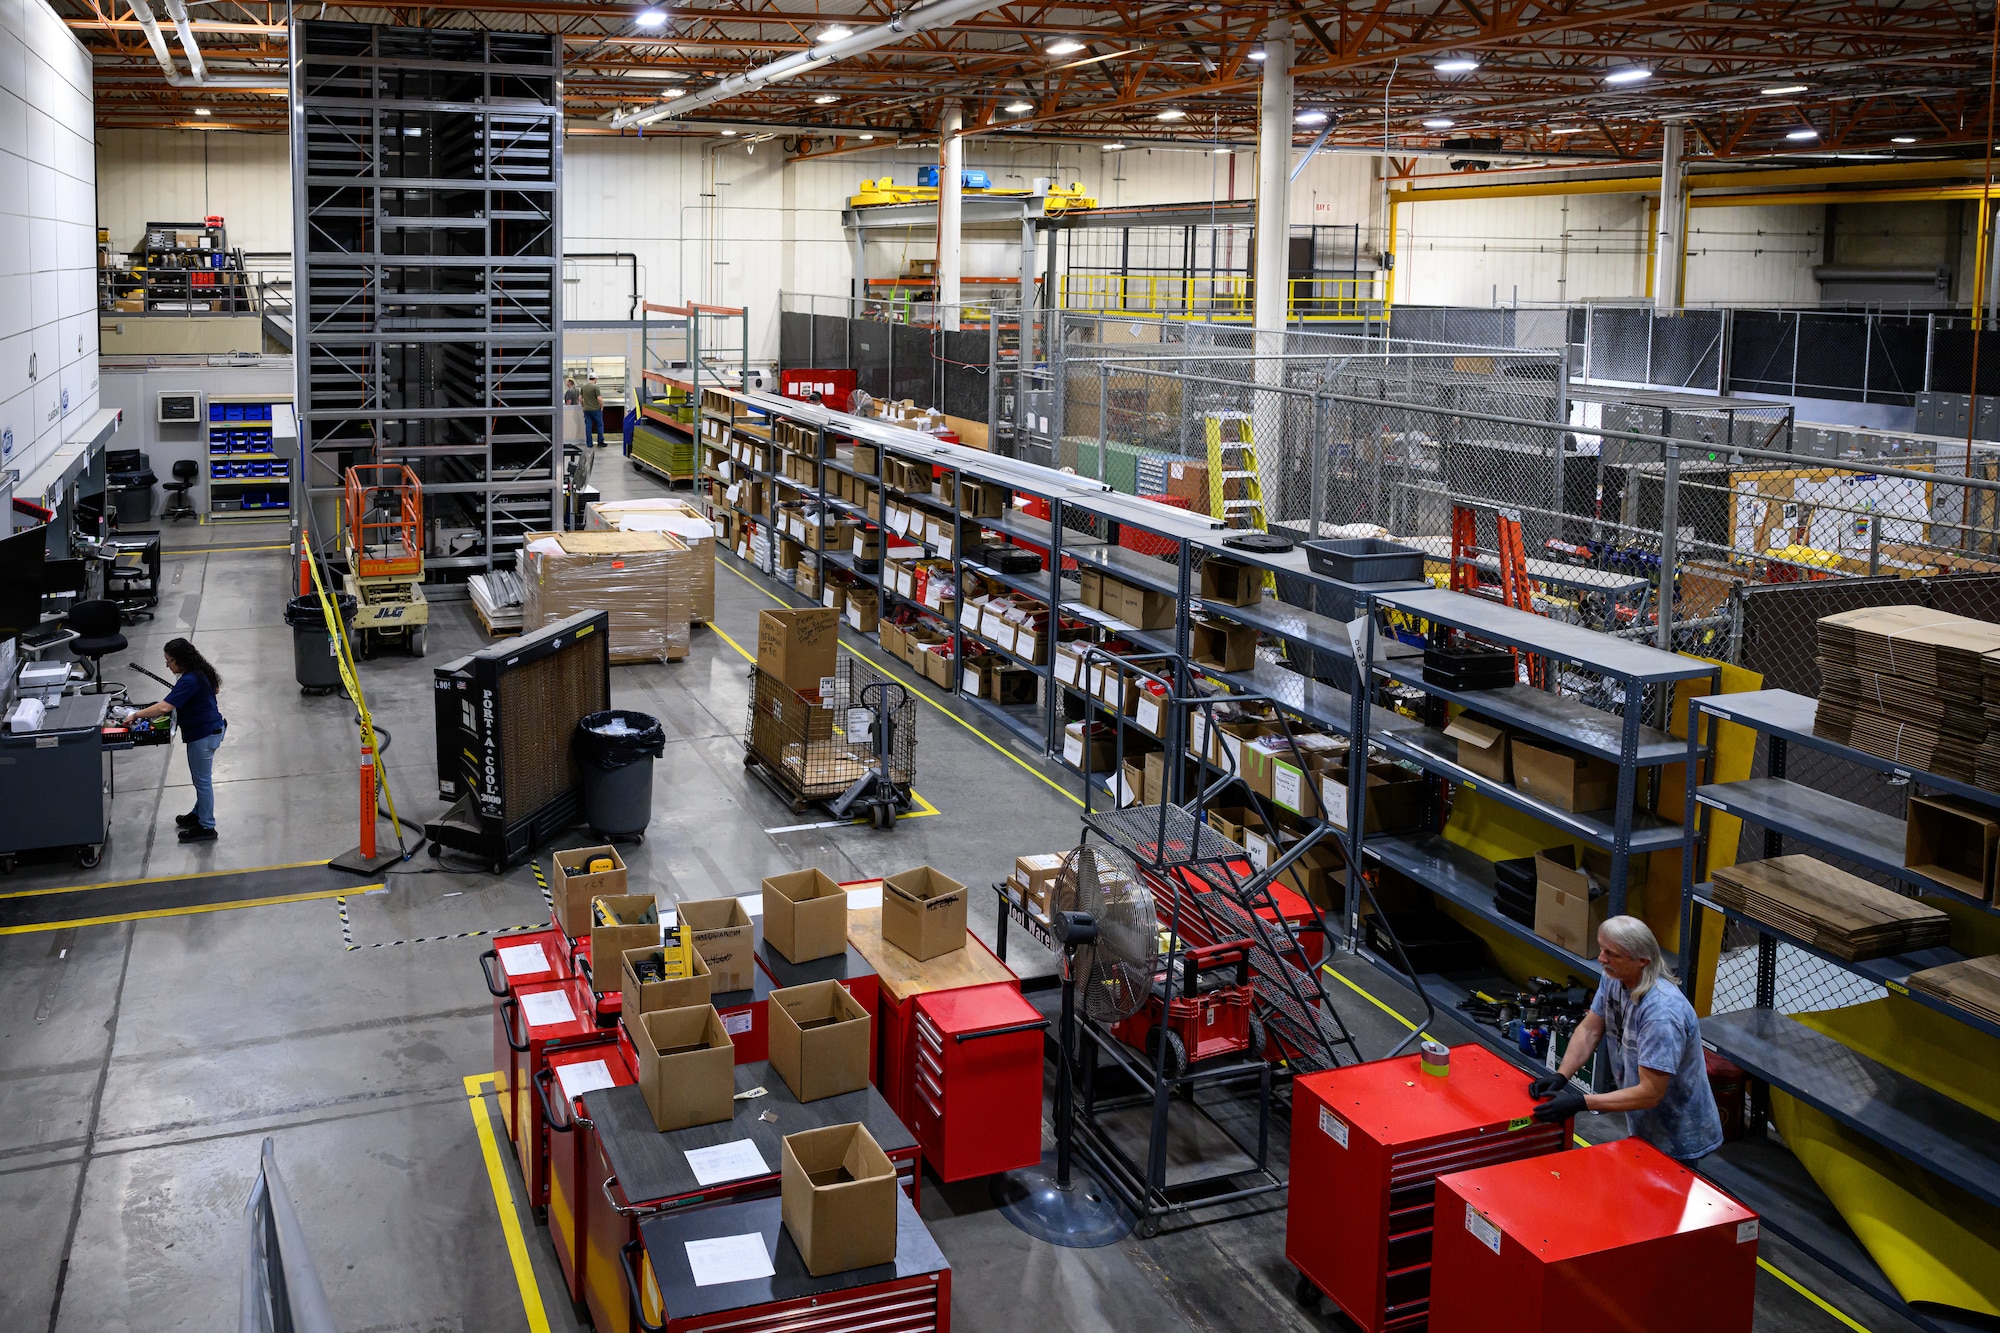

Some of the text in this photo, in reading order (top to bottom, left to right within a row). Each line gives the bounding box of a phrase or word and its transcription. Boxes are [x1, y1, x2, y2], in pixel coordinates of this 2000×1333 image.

[362, 563, 391, 573] SYTEK
[373, 606, 406, 619] JLG
[480, 792, 502, 805] 2000
[1008, 900, 1026, 927] Tool
